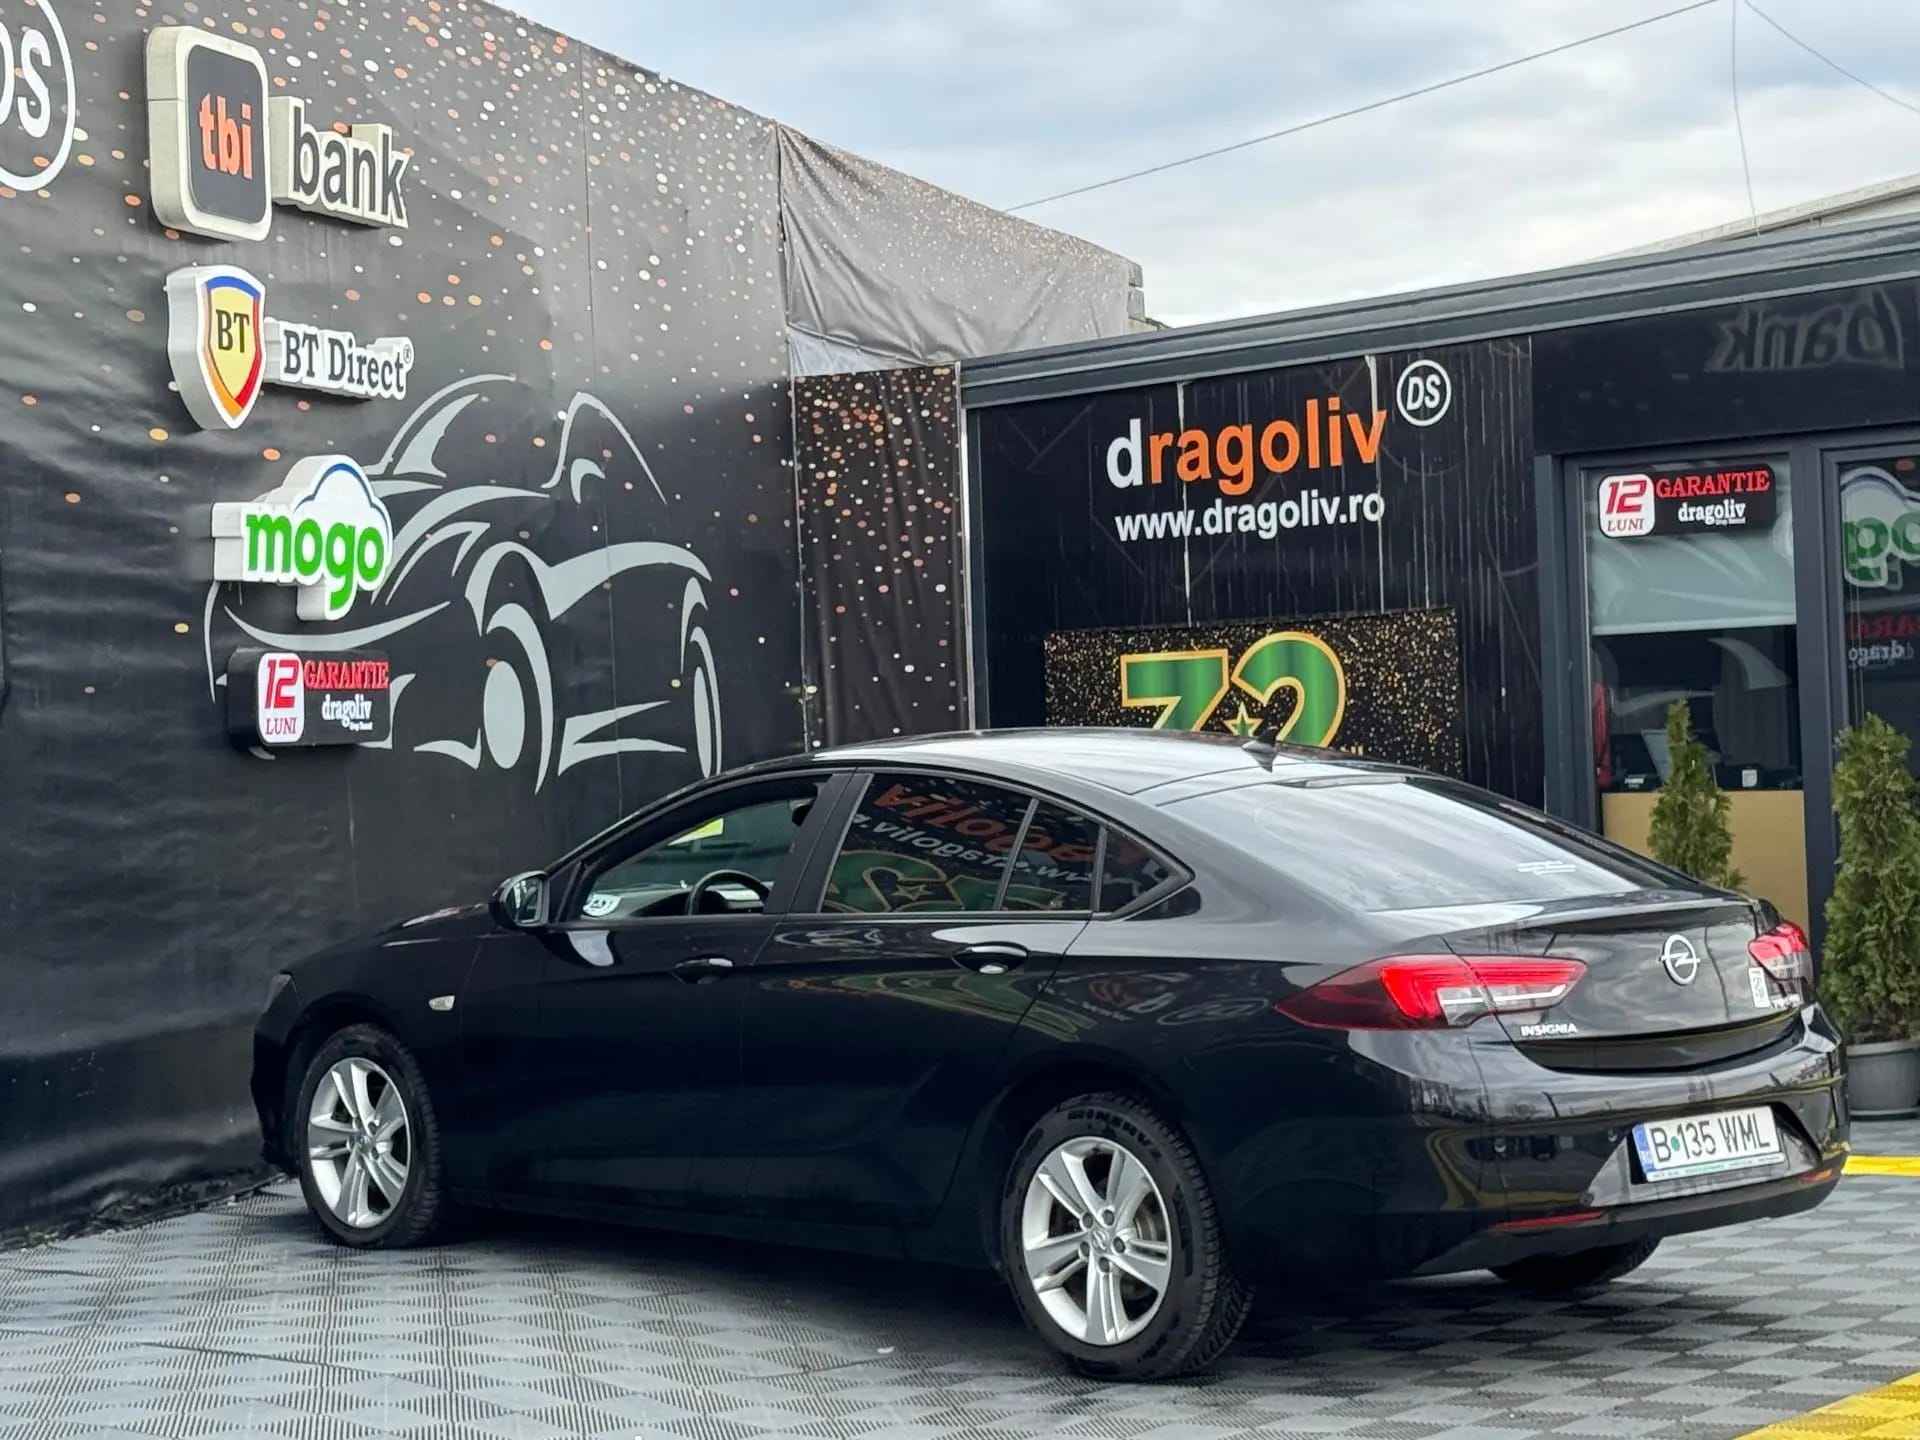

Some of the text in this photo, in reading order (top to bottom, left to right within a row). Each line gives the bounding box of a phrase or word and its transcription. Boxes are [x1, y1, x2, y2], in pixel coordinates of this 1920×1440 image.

[200, 93, 410, 220] tbi bank
[215, 309, 250, 353] BT
[283, 329, 319, 378] BT
[1406, 373, 1442, 411] DS
[1106, 396, 1388, 495] dragoliv
[1605, 479, 1648, 515] 12
[1656, 470, 1770, 499] GARANTIE
[1115, 489, 1386, 542] www.dragoliv.ro
[1607, 518, 1645, 533] LUNI
[1677, 499, 1746, 526] dragoliv
[246, 513, 385, 611] mogo
[265, 659, 300, 709] 12
[304, 660, 389, 690] GARANTIE
[265, 717, 297, 735] LUNI
[321, 694, 373, 728] dragoliv
[1520, 1022, 1578, 1037] INSIGNIA
[1649, 1127, 1672, 1163] B
[1676, 1119, 1717, 1160] 135
[1717, 1112, 1770, 1153] WML
